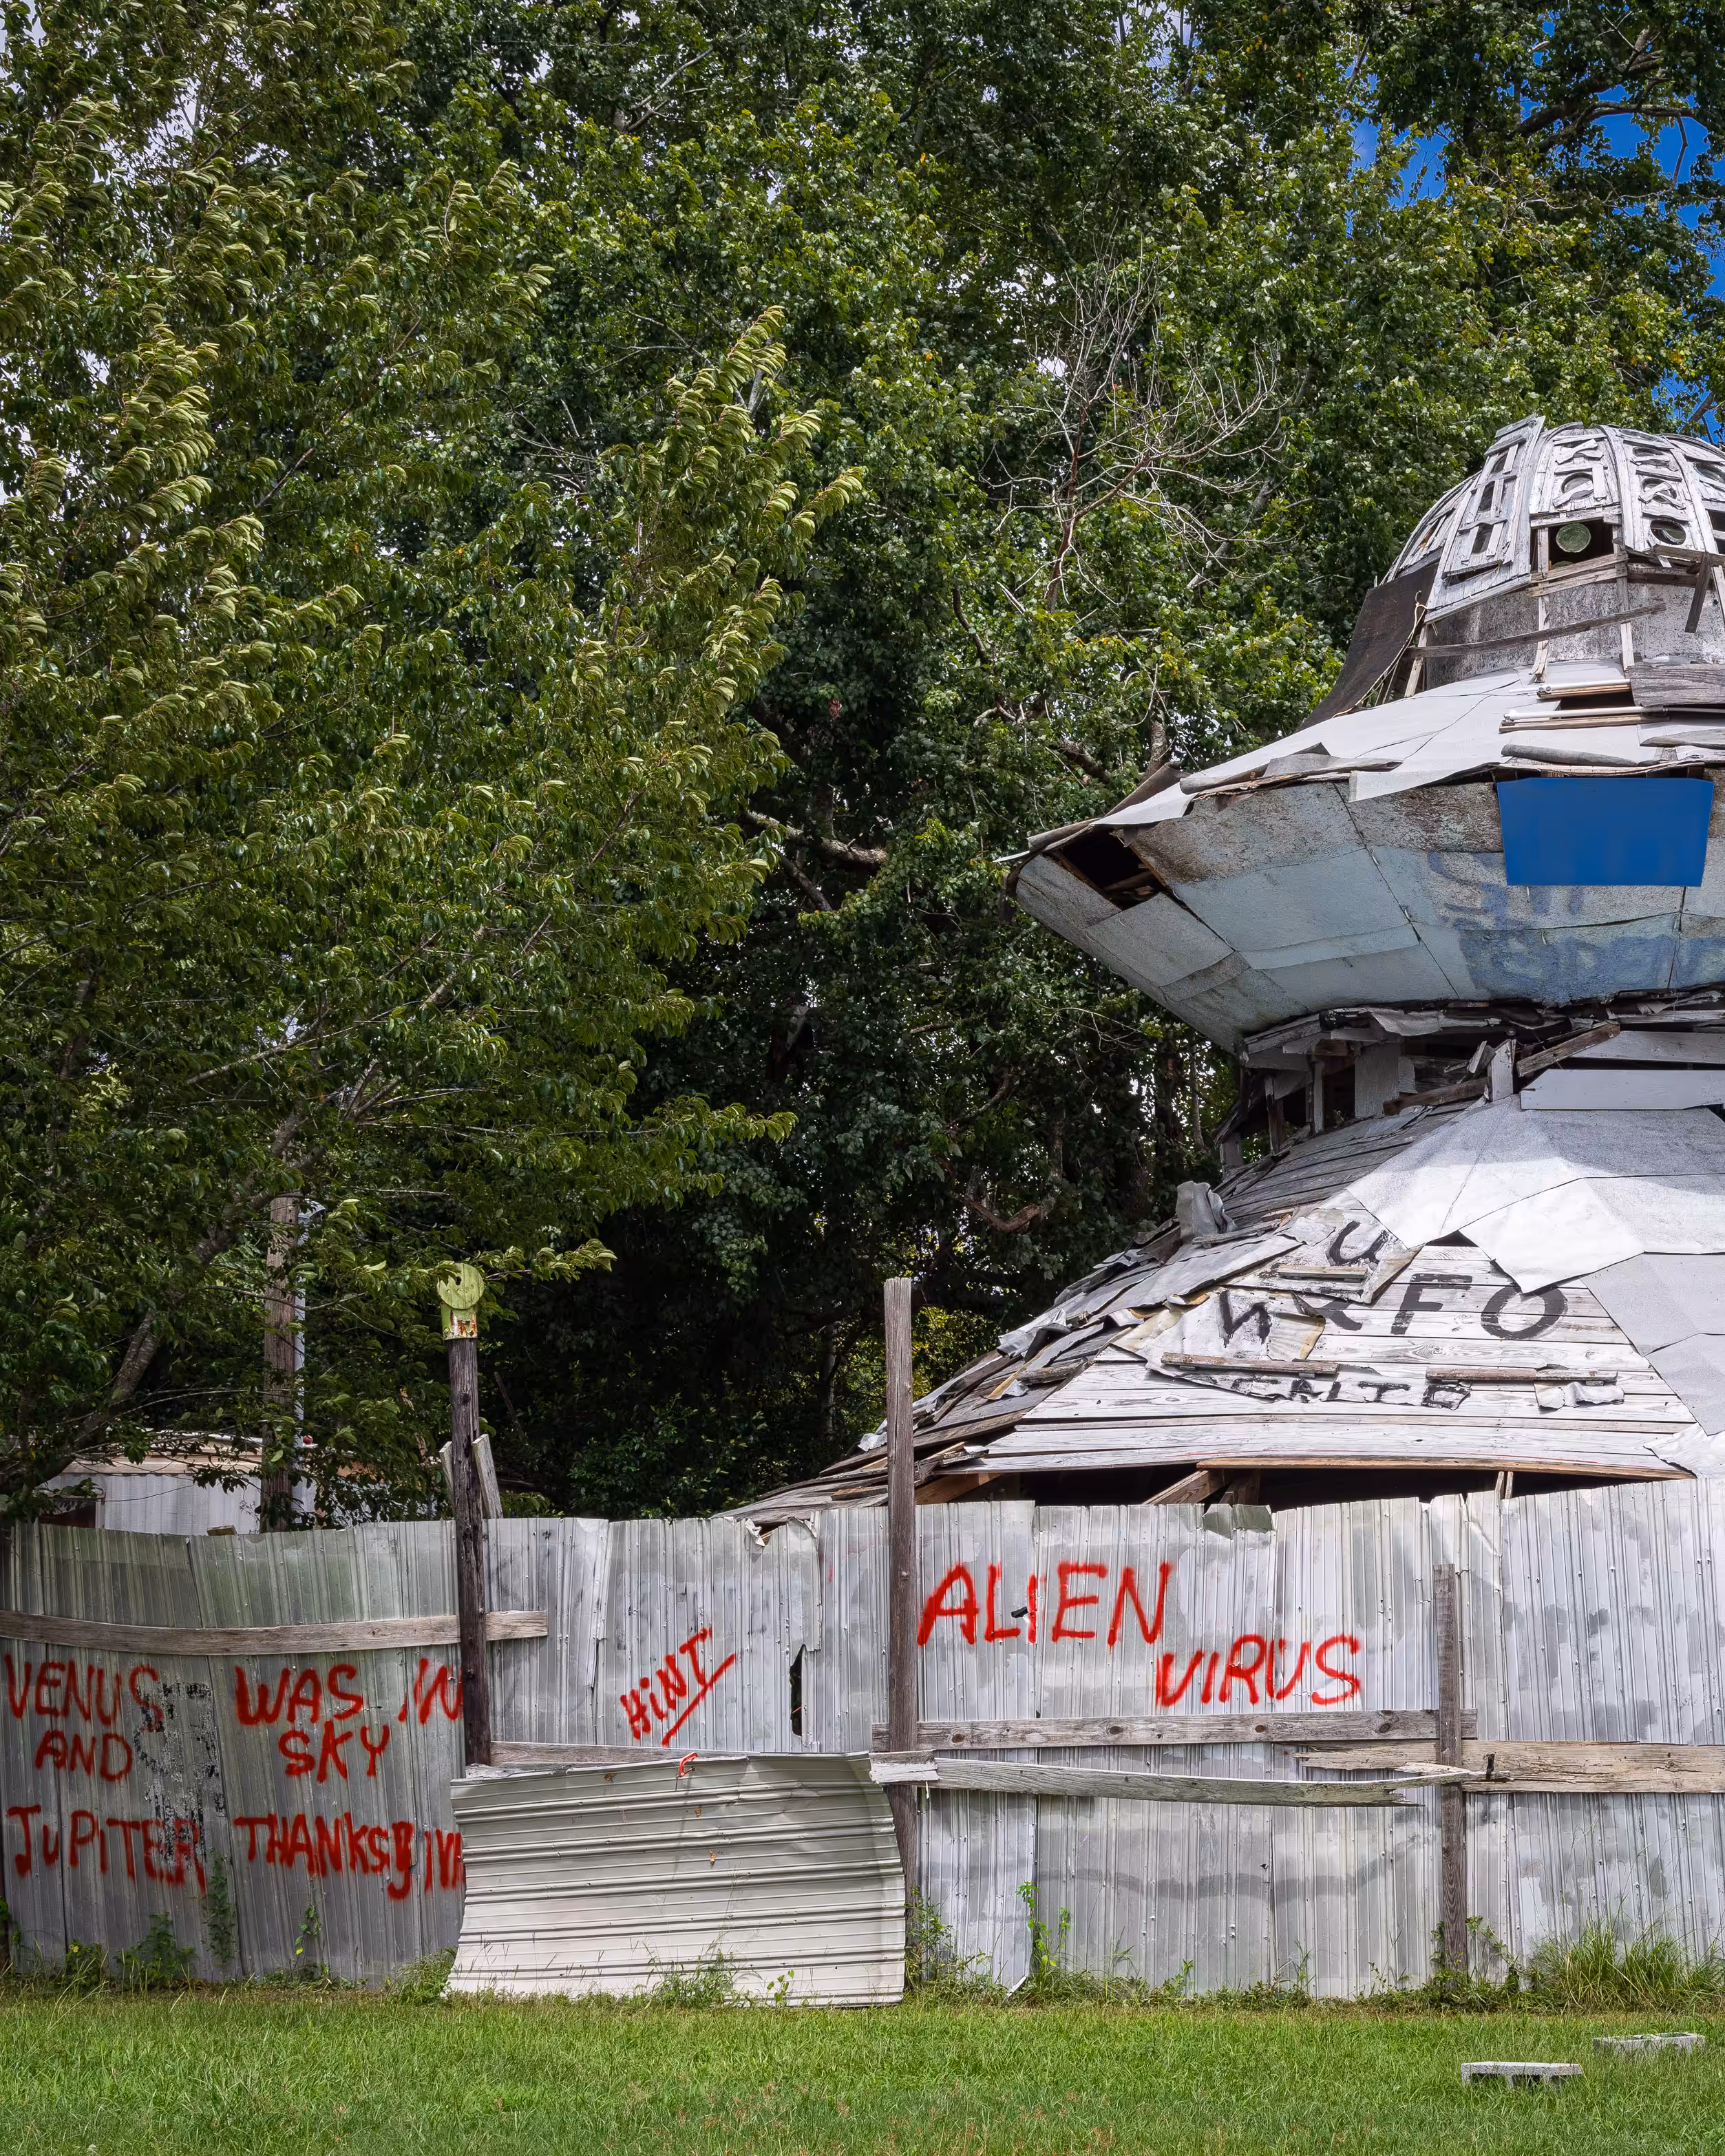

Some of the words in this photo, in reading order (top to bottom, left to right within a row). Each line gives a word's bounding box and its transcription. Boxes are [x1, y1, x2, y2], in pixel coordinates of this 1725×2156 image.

[917, 1560, 1174, 1647] ALIEN
[4, 1654, 165, 1733] VENUS
[235, 1663, 365, 1726] WAS
[1154, 1633, 1363, 1709] VIRUS
[35, 1729, 133, 1782] AND
[277, 1720, 390, 1784] SKY
